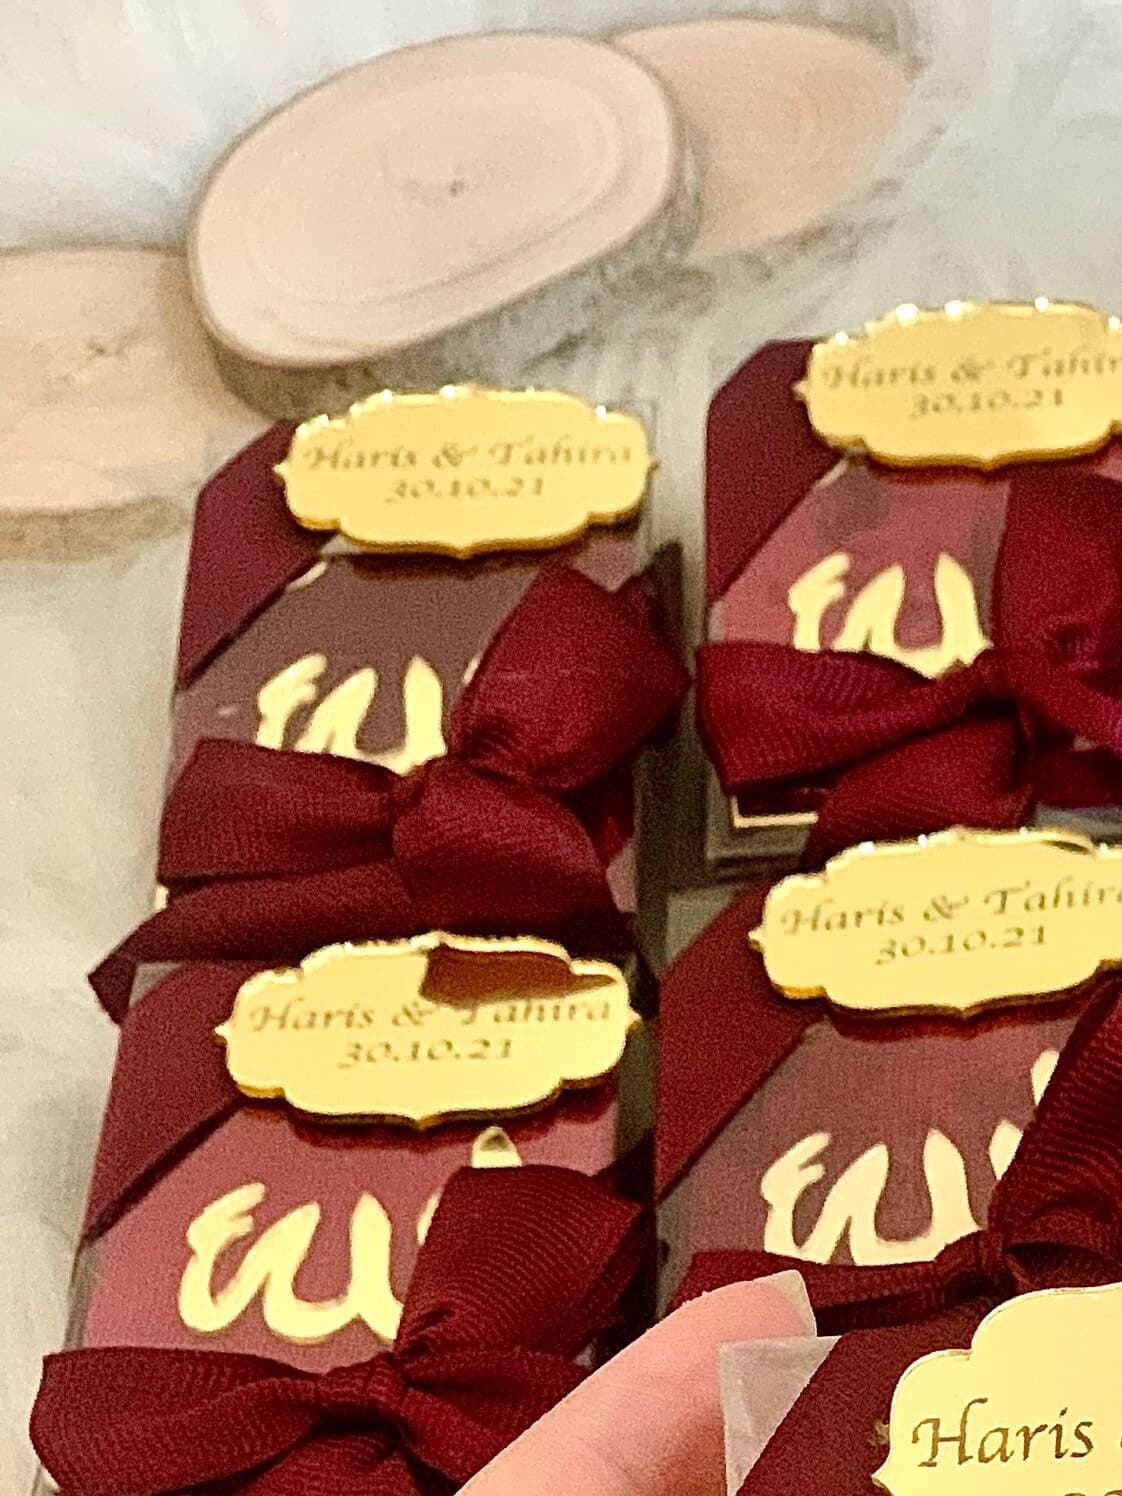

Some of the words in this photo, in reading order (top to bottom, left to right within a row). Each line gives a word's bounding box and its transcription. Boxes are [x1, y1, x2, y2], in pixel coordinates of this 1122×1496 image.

[822, 358, 937, 390] Haris
[950, 356, 995, 383] &
[910, 388, 1064, 419] 30.10.21
[303, 438, 417, 470] Haris
[431, 443, 478, 468] &
[489, 435, 632, 466] Tahira
[386, 477, 544, 504] 30.10.21
[780, 897, 905, 935] Haris
[922, 894, 970, 921] &
[874, 925, 1048, 967] 30.10.21
[250, 998, 375, 1032] Haris
[391, 1001, 434, 1028] &
[337, 1038, 512, 1068] 30.10.21
[911, 1397, 1094, 1468] Haris
